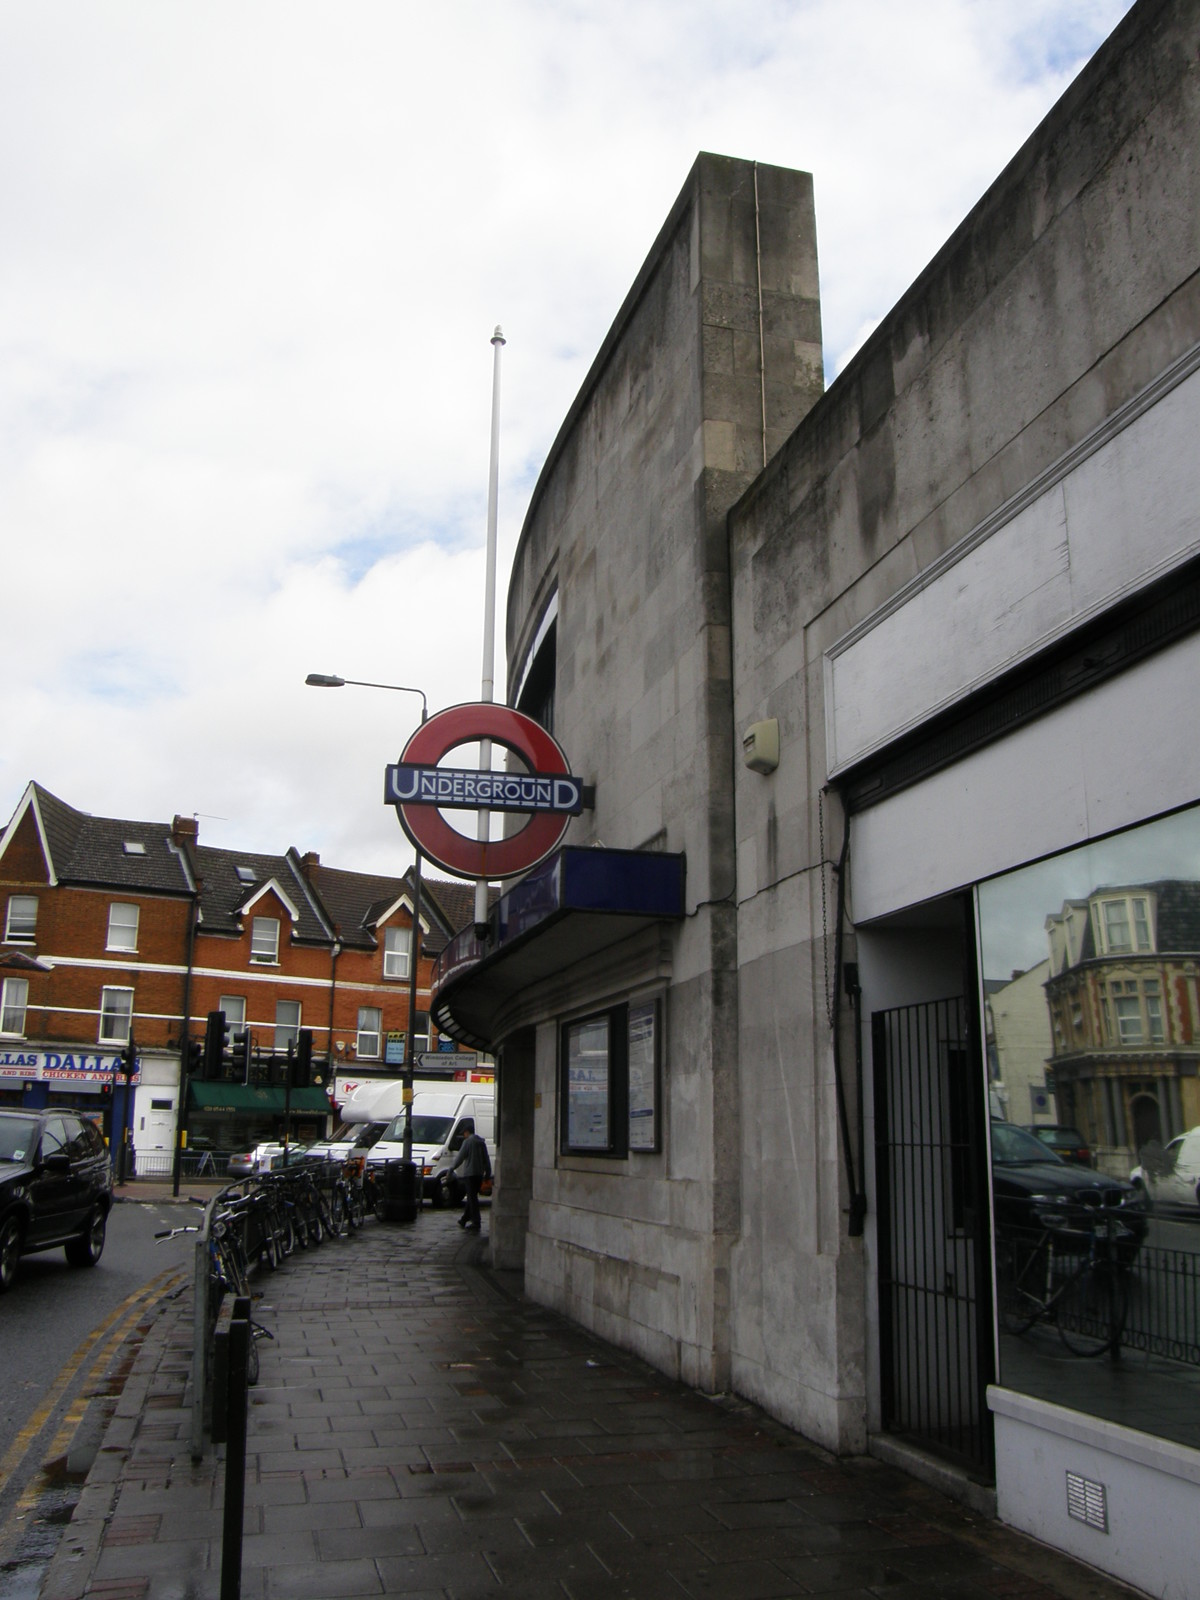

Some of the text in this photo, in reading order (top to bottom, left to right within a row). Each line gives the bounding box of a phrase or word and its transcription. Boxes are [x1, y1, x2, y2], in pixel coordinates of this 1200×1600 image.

[391, 768, 579, 809] UNDERGROUND
[42, 1071, 139, 1082] CHICKEN AND RIS
